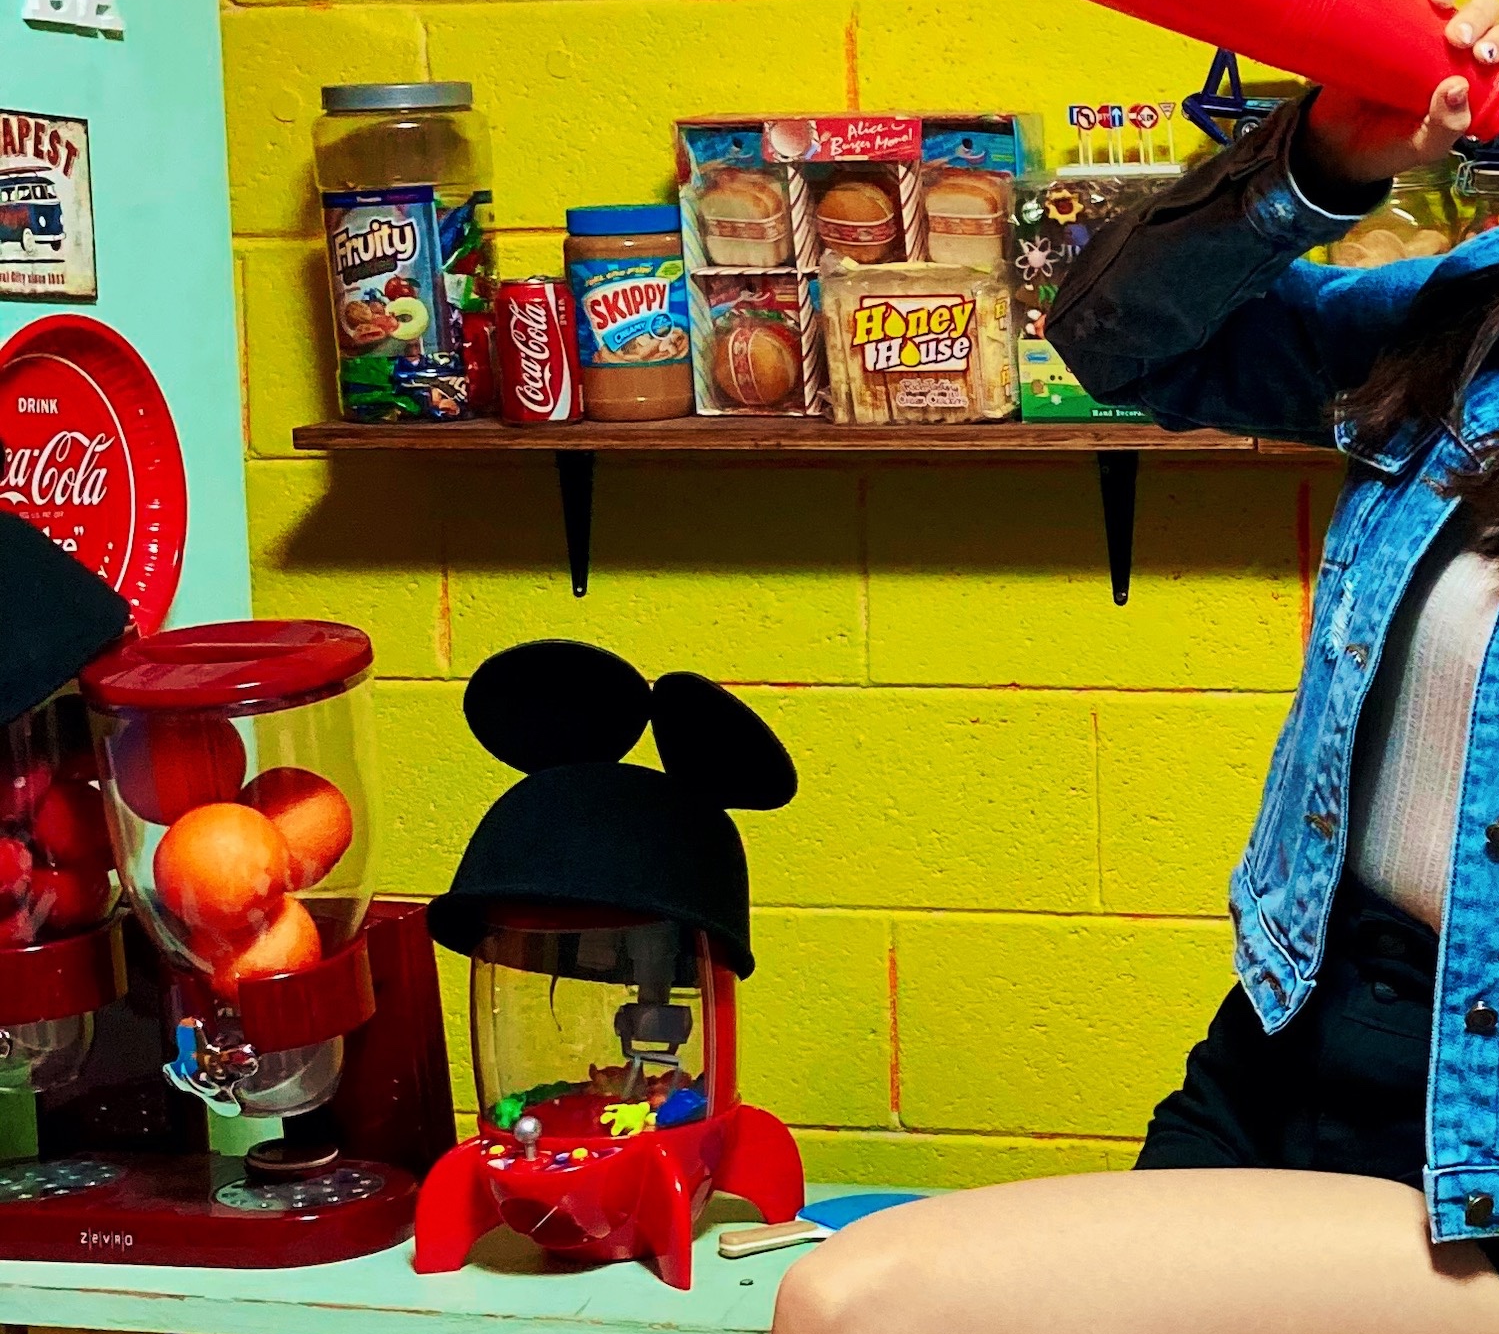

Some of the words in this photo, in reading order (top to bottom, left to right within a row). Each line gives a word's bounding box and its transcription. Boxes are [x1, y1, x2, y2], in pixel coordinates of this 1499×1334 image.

[0, 116, 80, 178] APEST
[333, 219, 417, 271] Fruity
[590, 283, 667, 330] SKIPPY
[508, 297, 554, 413] Coca-Cola
[18, 397, 59, 414] DRINK
[0, 430, 116, 505] a-Cola
